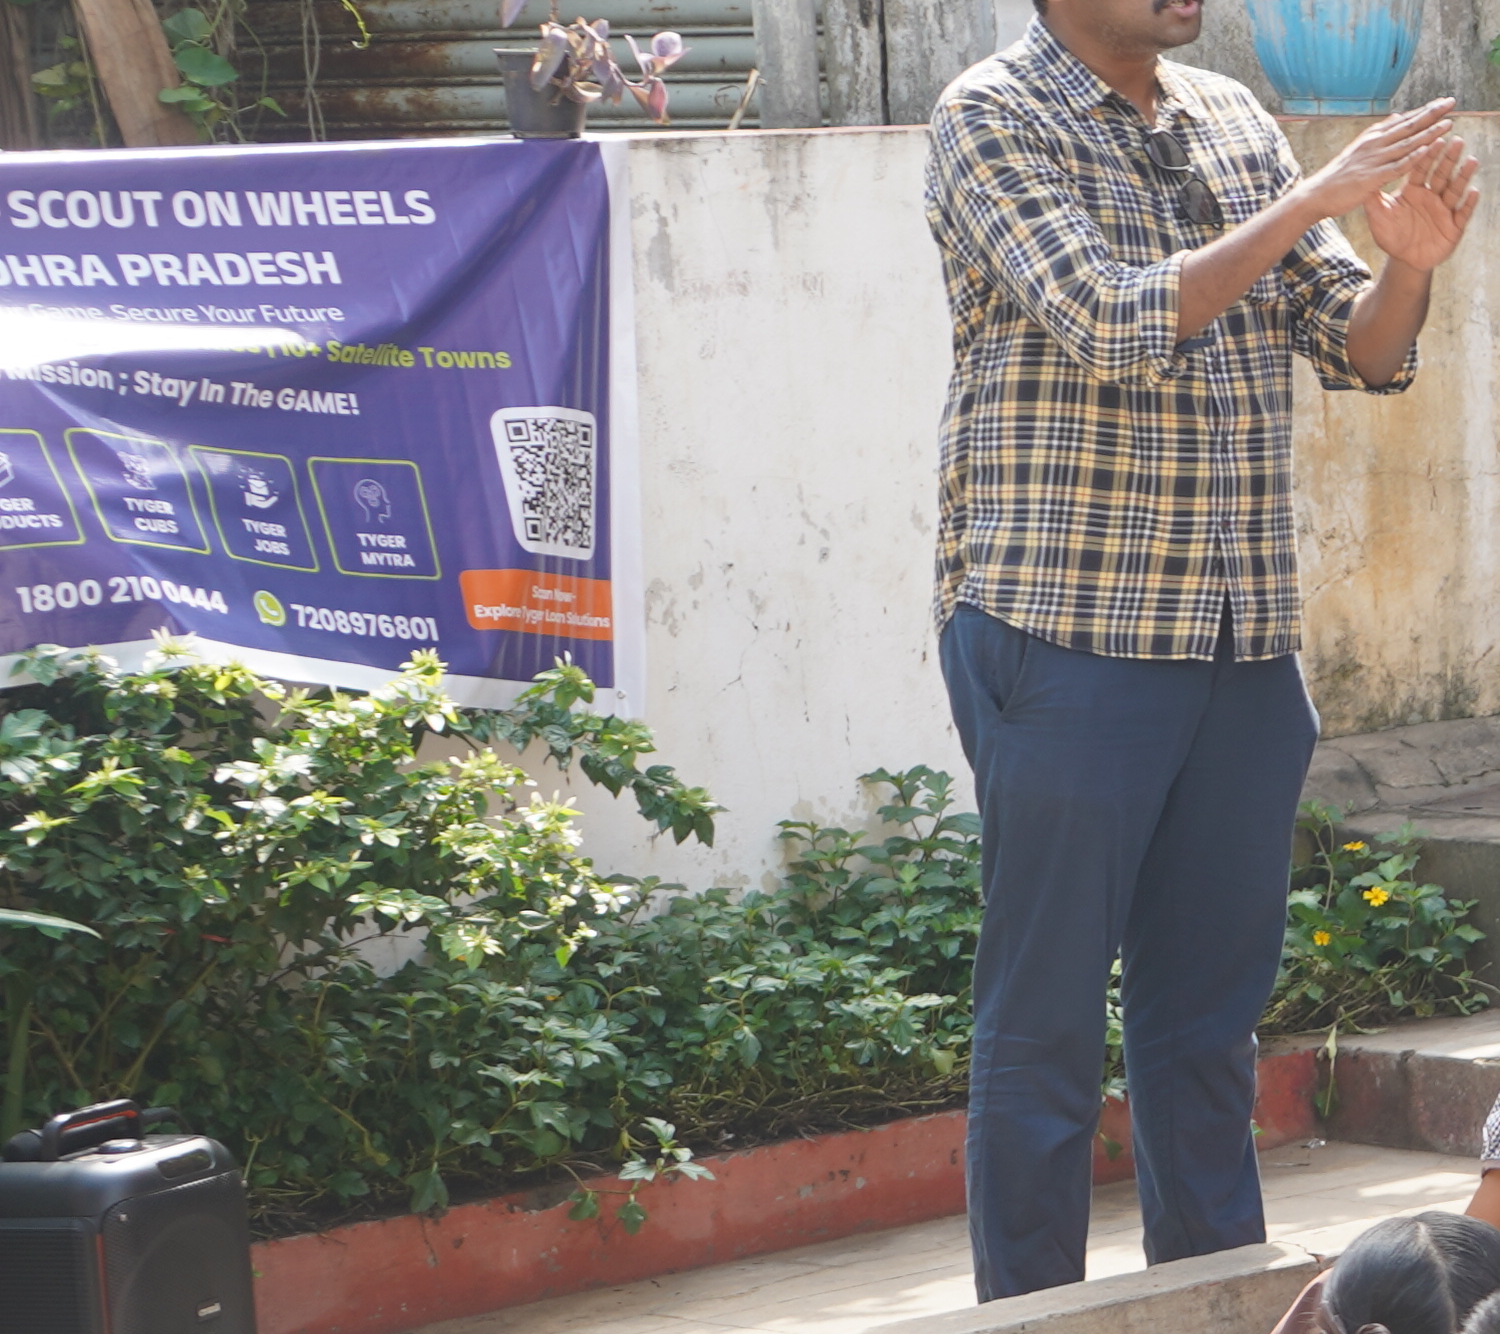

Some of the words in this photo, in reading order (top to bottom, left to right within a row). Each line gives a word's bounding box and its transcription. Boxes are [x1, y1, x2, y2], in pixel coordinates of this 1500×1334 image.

[7, 190, 163, 228] SCOUT
[172, 190, 243, 227] ON
[245, 189, 437, 226] WHEELS
[117, 251, 342, 286] PRADESH
[110, 304, 199, 322] Secure
[198, 304, 257, 323] Your
[258, 304, 344, 323] Future
[327, 340, 415, 367] Satellite
[418, 346, 512, 369] Towns
[134, 370, 197, 407] Stay
[200, 378, 225, 405] In
[230, 381, 272, 409] The
[277, 388, 360, 416] GAME!
[123, 496, 175, 516] TYGER
[0, 514, 64, 530] DUCTS
[134, 517, 179, 534] CUBS
[241, 518, 287, 538] TYGER
[254, 539, 290, 556] JOBS
[356, 533, 407, 549] TYGER
[361, 552, 415, 567] MYTRA
[15, 579, 103, 613] 1800
[290, 603, 439, 642] 7208976801
